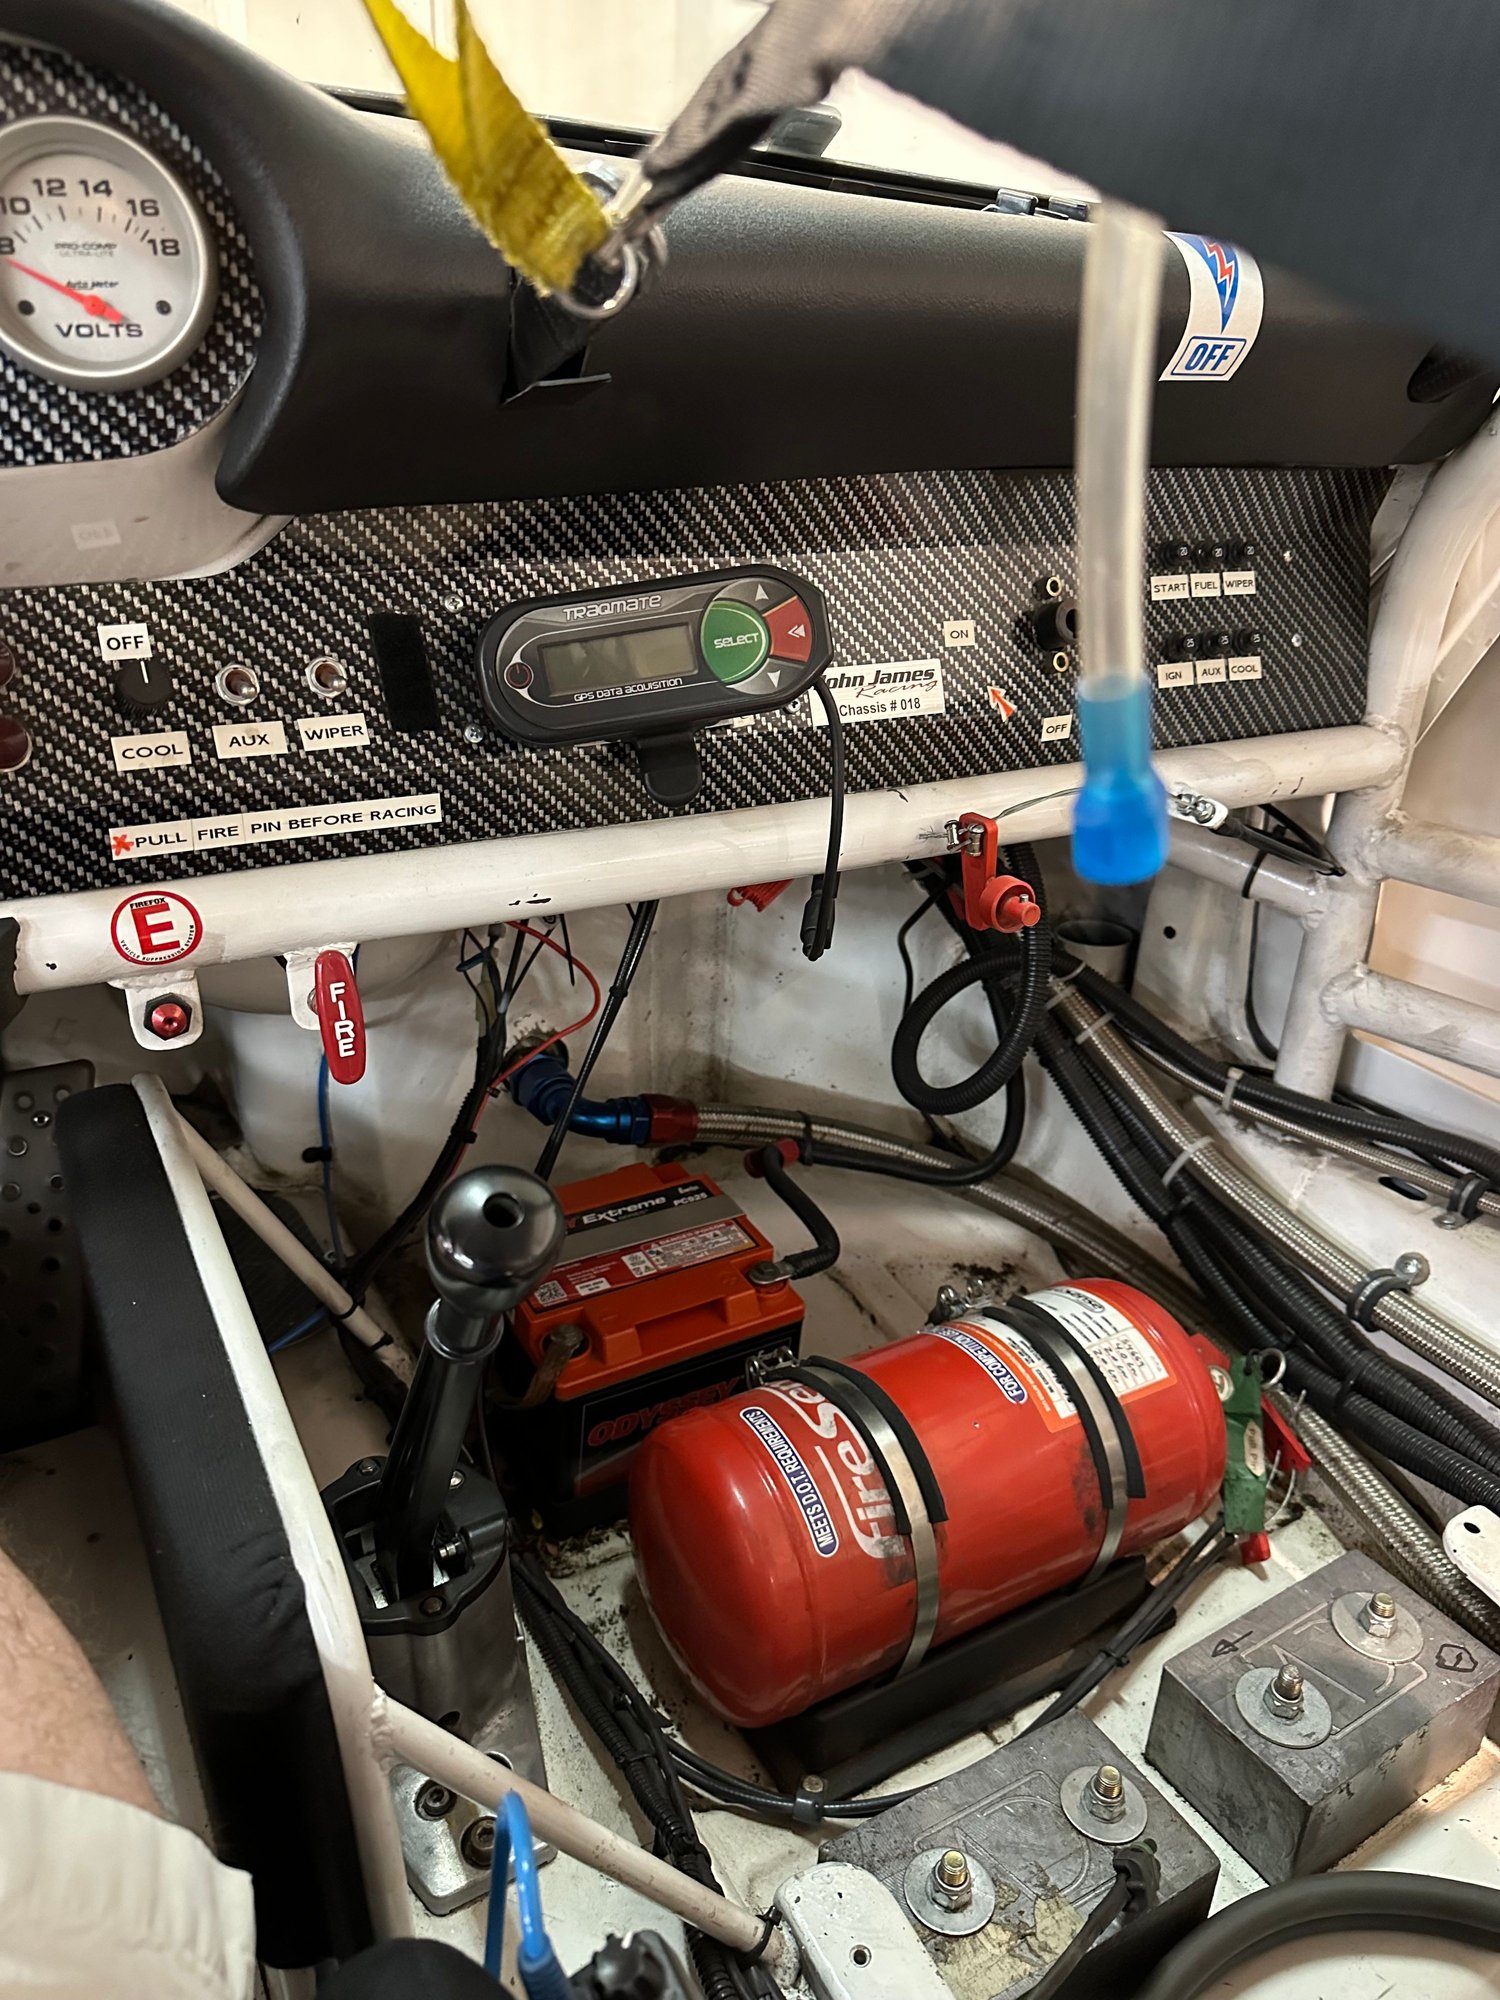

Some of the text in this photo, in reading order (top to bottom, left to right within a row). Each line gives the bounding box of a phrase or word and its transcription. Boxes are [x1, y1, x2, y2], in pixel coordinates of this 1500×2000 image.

[33, 179, 66, 197] 12
[79, 179, 112, 197] 14
[0, 196, 31, 215] 10
[127, 199, 160, 217] 16
[147, 238, 180, 256] 18
[56, 323, 143, 338] VOLTS
[1185, 343, 1236, 372] OFF
[1154, 582, 1187, 593] START
[1194, 581, 1218, 590] FUEL
[1225, 579, 1254, 588] WIPER
[106, 635, 144, 650] OFF
[714, 631, 759, 649] SELECT
[950, 629, 969, 640] ON
[868, 668, 935, 685] James
[1165, 671, 1182, 681] IGN
[1201, 667, 1222, 677] AUX
[1231, 664, 1259, 674] COOL
[573, 692, 594, 702] GPS
[596, 688, 623, 700] DATA
[854, 680, 938, 698] Racing
[839, 697, 921, 717] Chassis # 018
[304, 724, 364, 741] WIPER
[1046, 723, 1068, 735] OFF
[229, 733, 270, 748] AUX
[121, 744, 184, 760] COOL
[135, 804, 437, 848] PULL FIRE PIN BEFORE RACING
[130, 897, 166, 910] FIREFOX
[131, 902, 181, 955] E
[120, 939, 141, 959] VEHICLE
[142, 947, 185, 961] SUPPRESSION
[329, 982, 355, 1057] FIRE
[582, 1197, 667, 1223] Extreme
[955, 1336, 1006, 1376] COMPETITION
[1000, 1376, 1023, 1396] FOR
[746, 1410, 834, 1548] MEETS D.O.T. REQUIREMENTS
